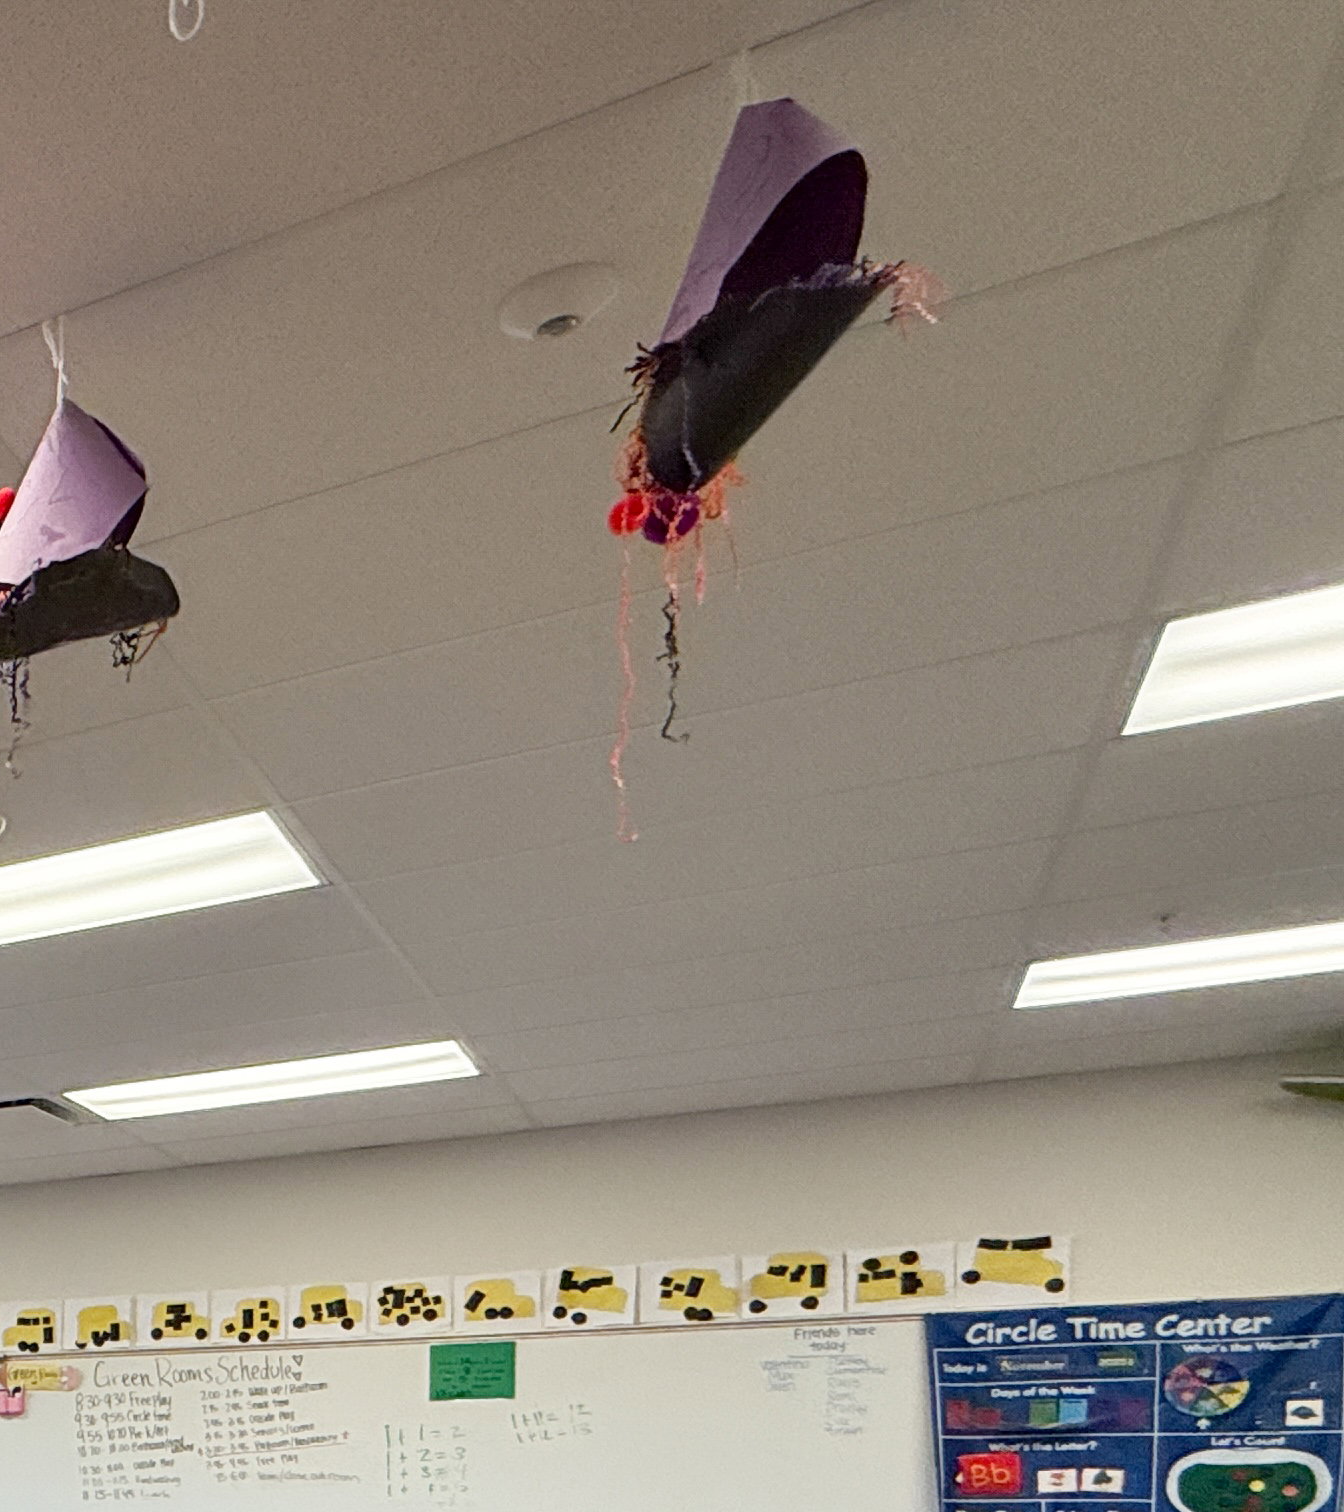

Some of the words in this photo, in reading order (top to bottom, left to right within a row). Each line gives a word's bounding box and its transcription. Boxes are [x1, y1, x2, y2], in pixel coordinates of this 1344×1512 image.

[794, 1327, 841, 1340] Friends
[965, 1318, 1058, 1345] Circle
[1066, 1315, 1146, 1340] Time
[1155, 1313, 1272, 1337] Center
[94, 1360, 151, 1388] Green
[155, 1356, 213, 1387] Rooms
[215, 1354, 293, 1385] Schedule
[991, 1388, 1021, 1400] Days
[1022, 1386, 1037, 1397] of
[1038, 1386, 1059, 1396] the
[1060, 1385, 1096, 1396] Week
[988, 1441, 1031, 1452] What's
[416, 1448, 433, 1462] 2
[970, 1464, 1010, 1487] Bb
